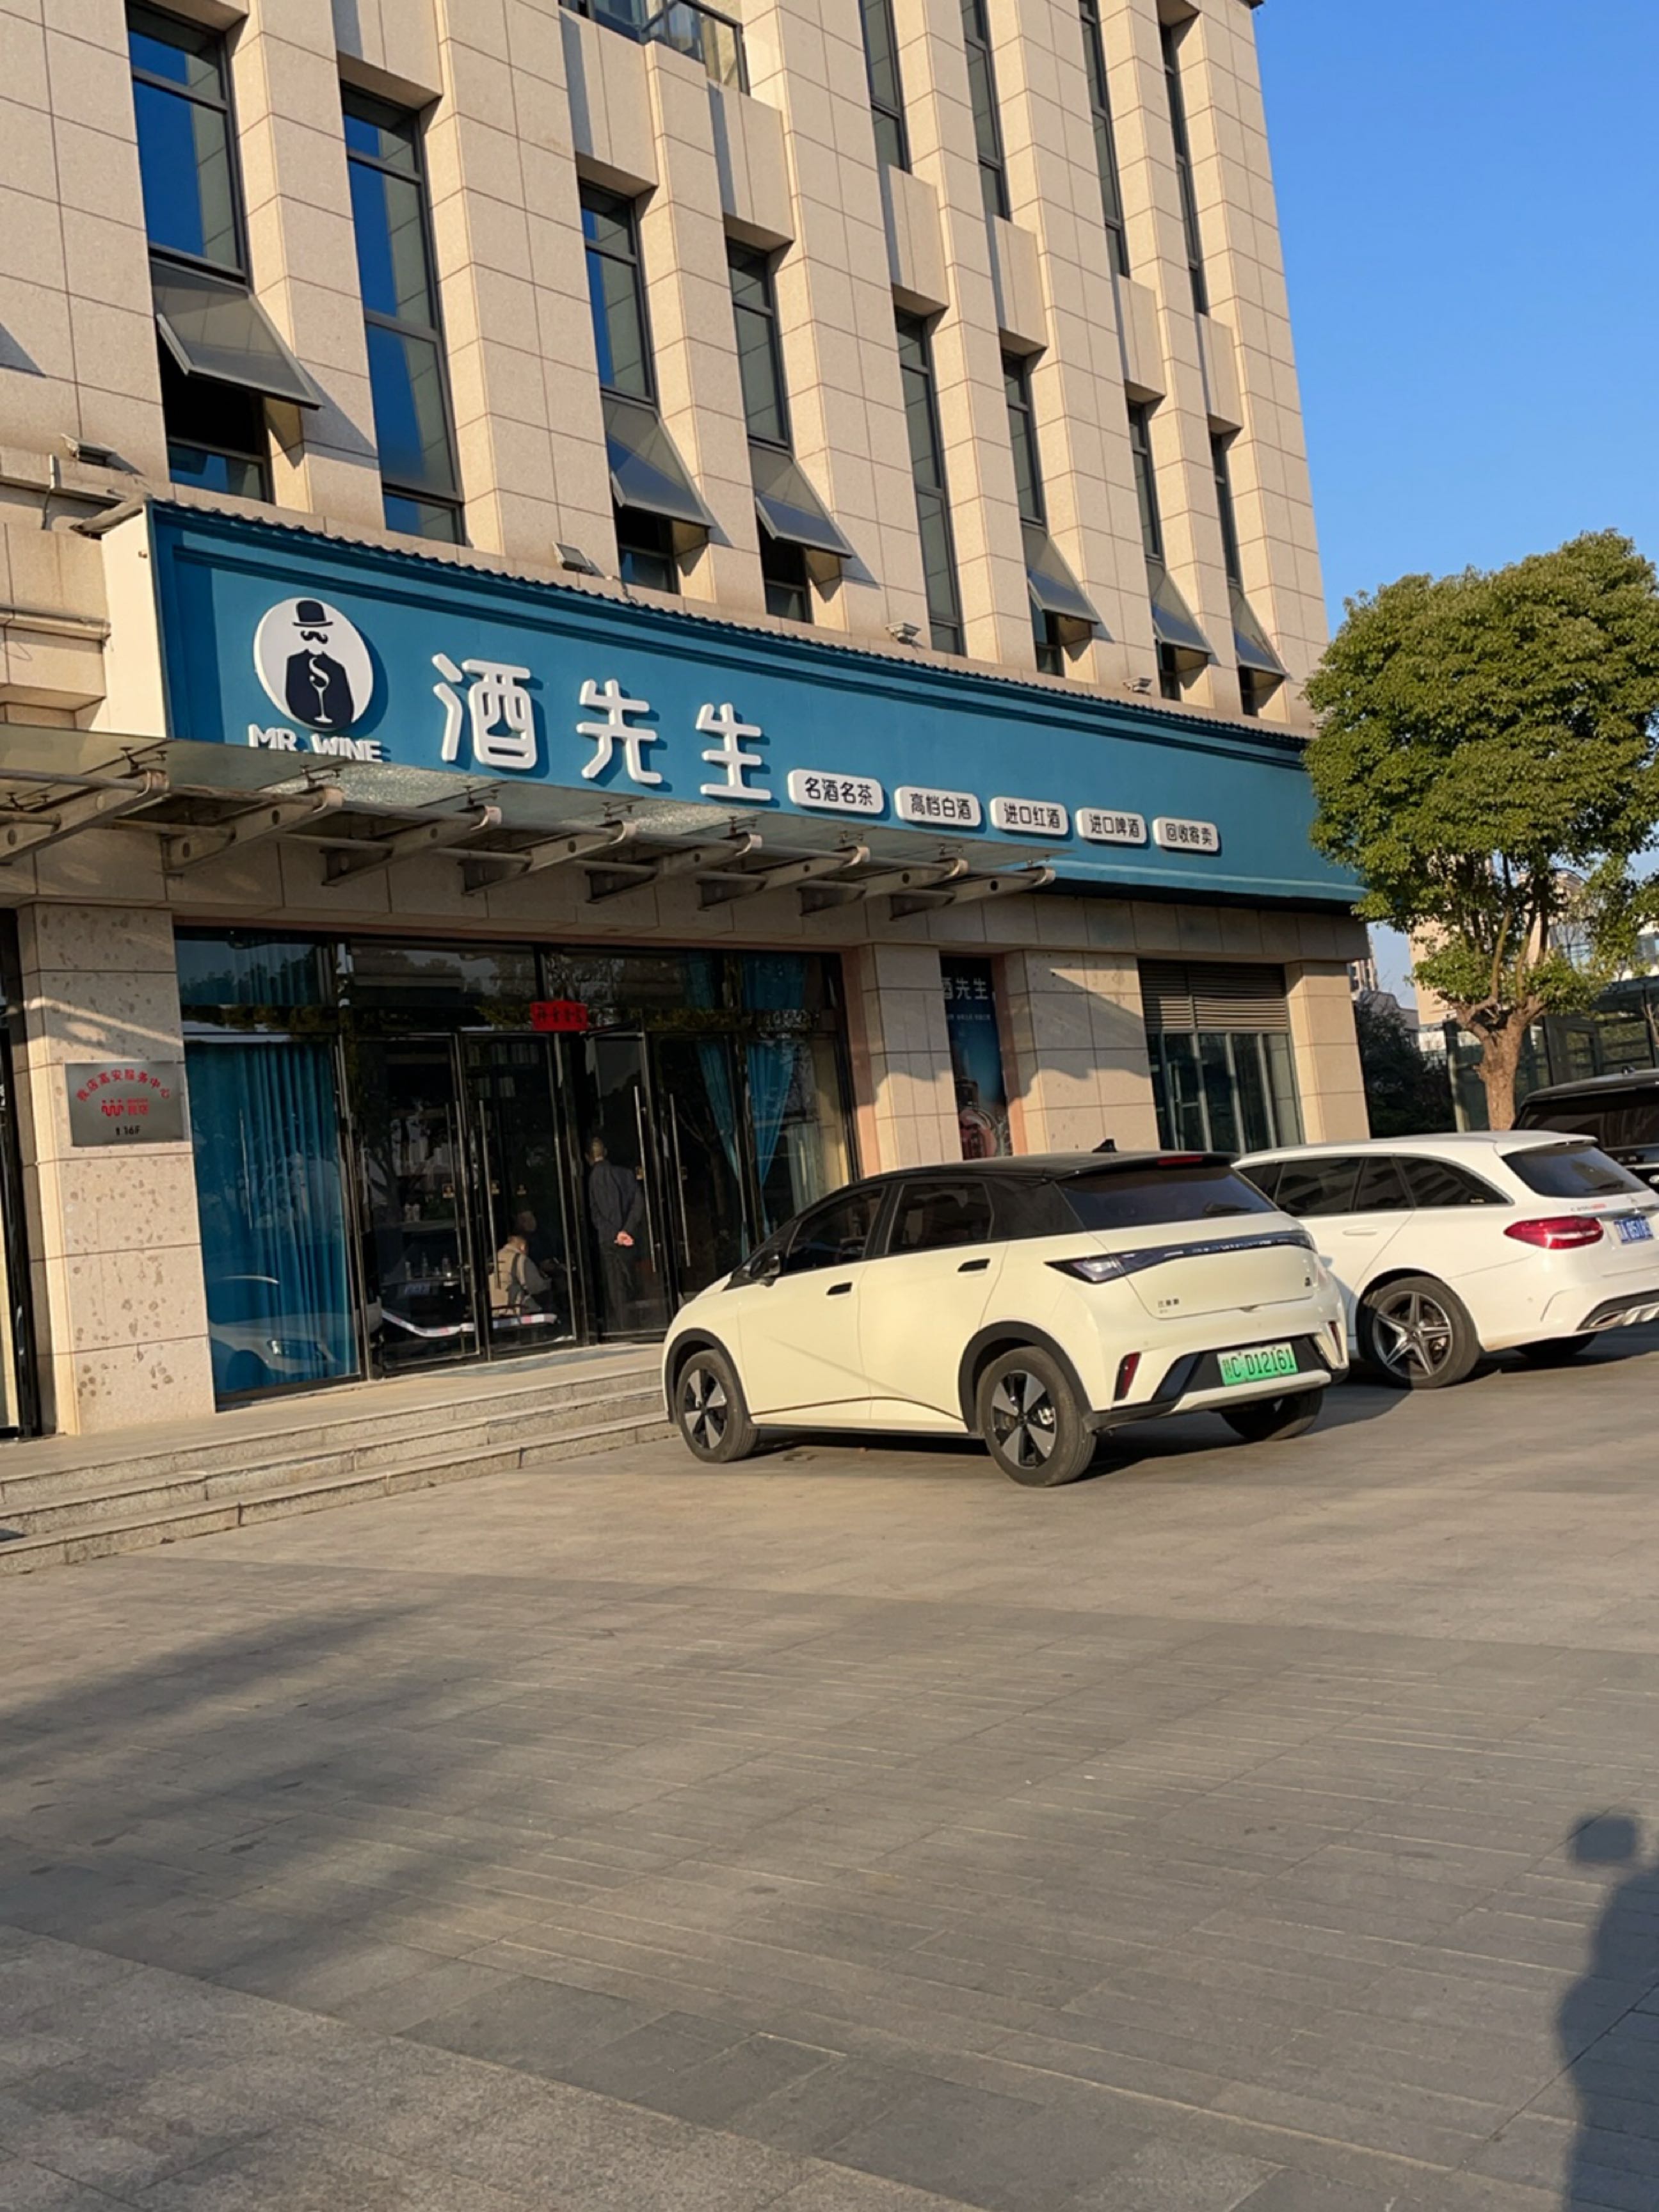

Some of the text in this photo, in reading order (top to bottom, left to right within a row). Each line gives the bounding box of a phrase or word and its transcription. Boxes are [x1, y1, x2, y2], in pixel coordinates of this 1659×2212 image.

[431, 652, 772, 801] 酒先生
[310, 733, 383, 762] WINE
[805, 776, 873, 806] 名酒名茶
[909, 793, 972, 821] 高档白酒
[1004, 802, 1061, 829] 进口红酒
[1089, 813, 1140, 838] 进口啤酒
[1166, 823, 1213, 846] 回收寄卖
